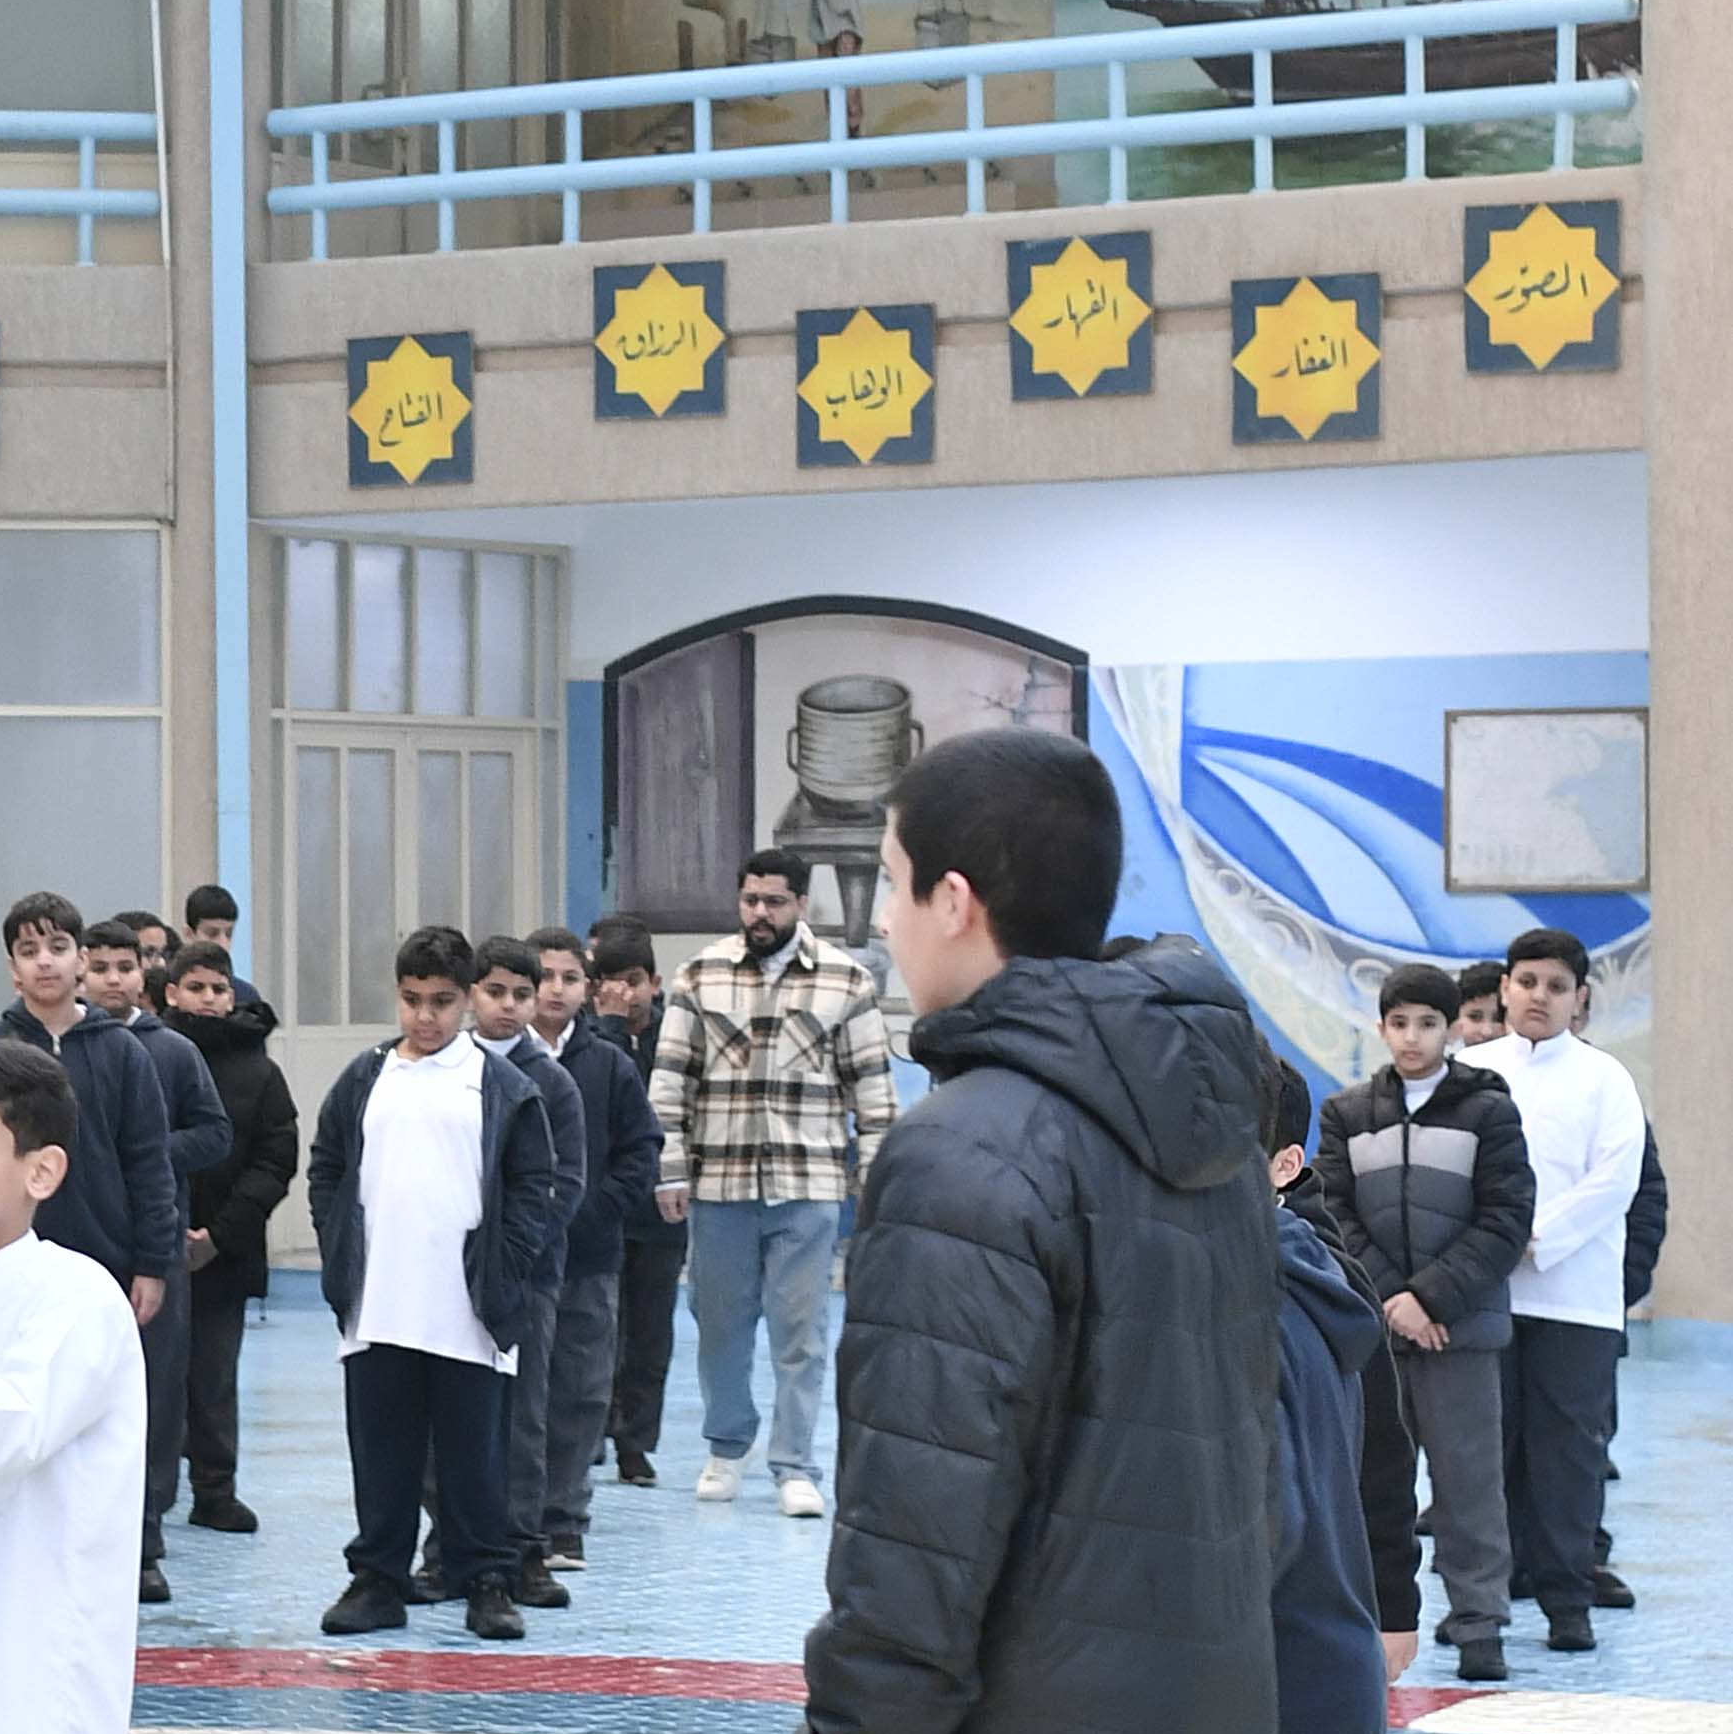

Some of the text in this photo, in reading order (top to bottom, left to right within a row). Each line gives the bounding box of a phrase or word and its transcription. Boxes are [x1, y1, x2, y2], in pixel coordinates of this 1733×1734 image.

[1043, 279, 1118, 339] القهار
[1271, 334, 1347, 378] الغفار
[826, 365, 902, 419] الوهاب
[378, 392, 443, 447] الفتاح
